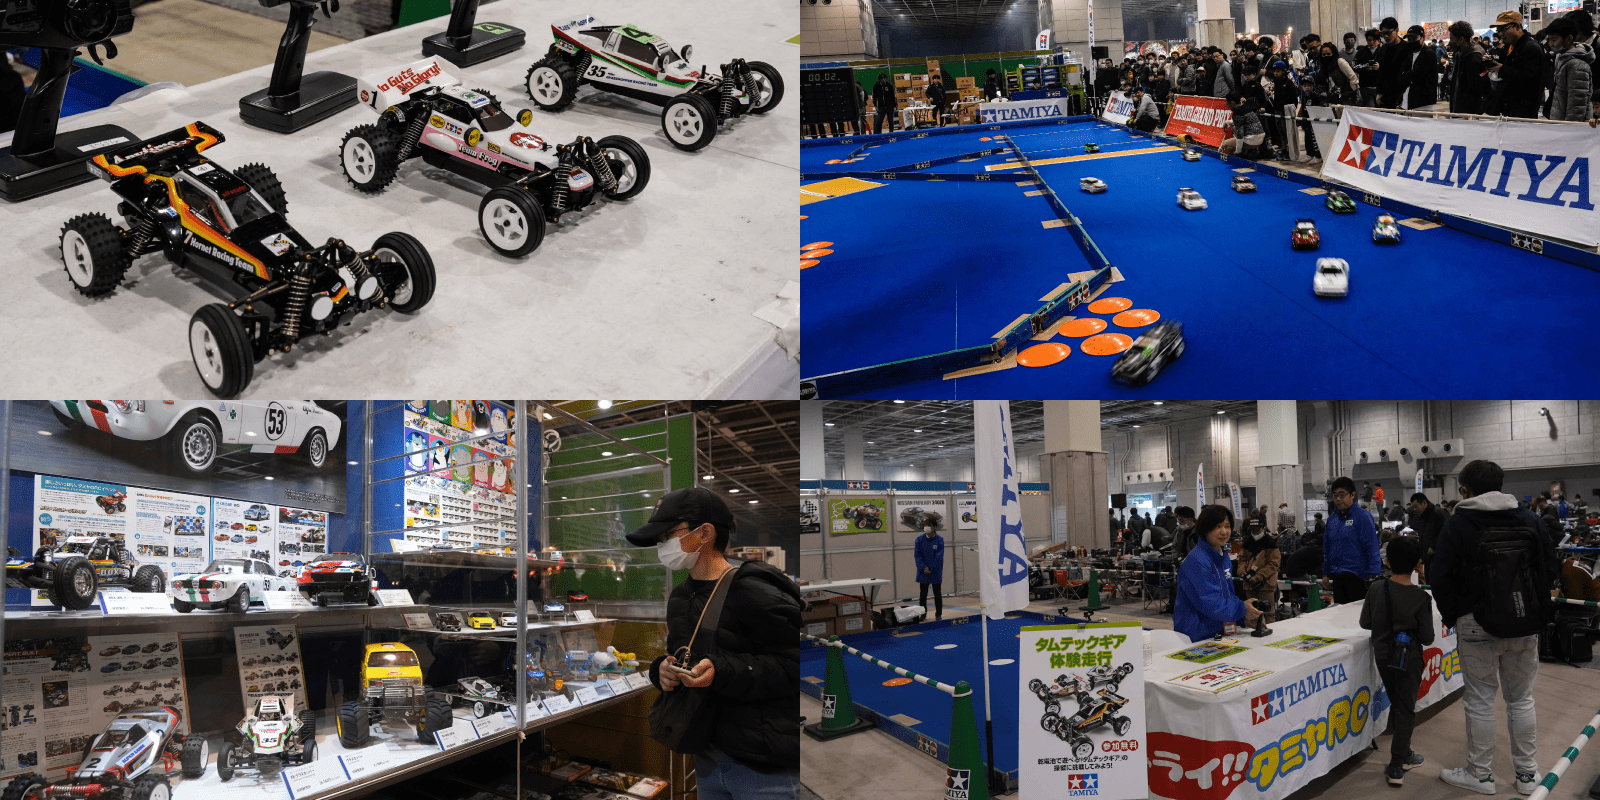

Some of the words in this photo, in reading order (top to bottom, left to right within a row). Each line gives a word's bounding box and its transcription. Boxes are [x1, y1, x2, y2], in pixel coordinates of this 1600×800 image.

[387, 68, 414, 87] Guts
[410, 61, 441, 85] Glory!
[588, 65, 608, 78] 35
[369, 90, 378, 110] 1
[998, 105, 1062, 121] TAMIYA
[458, 143, 478, 159] Team
[479, 151, 498, 167] Frog
[1397, 139, 1595, 211] TAMIYA
[183, 230, 193, 245] 7
[190, 237, 212, 256] Hornet
[212, 247, 235, 266] Racing
[234, 256, 254, 273] Team
[267, 408, 285, 435] 53
[1035, 633, 1128, 653] タムテックギア
[1049, 650, 1113, 670] 体験走行
[1285, 663, 1348, 707] TAMIYA
[1102, 740, 1139, 752] 参加無料
[1247, 686, 1371, 792] タミヤRC
[85, 757, 102, 769] 2
[1147, 750, 1249, 791] ライ!!
[1068, 789, 1099, 797] TAMIYA
